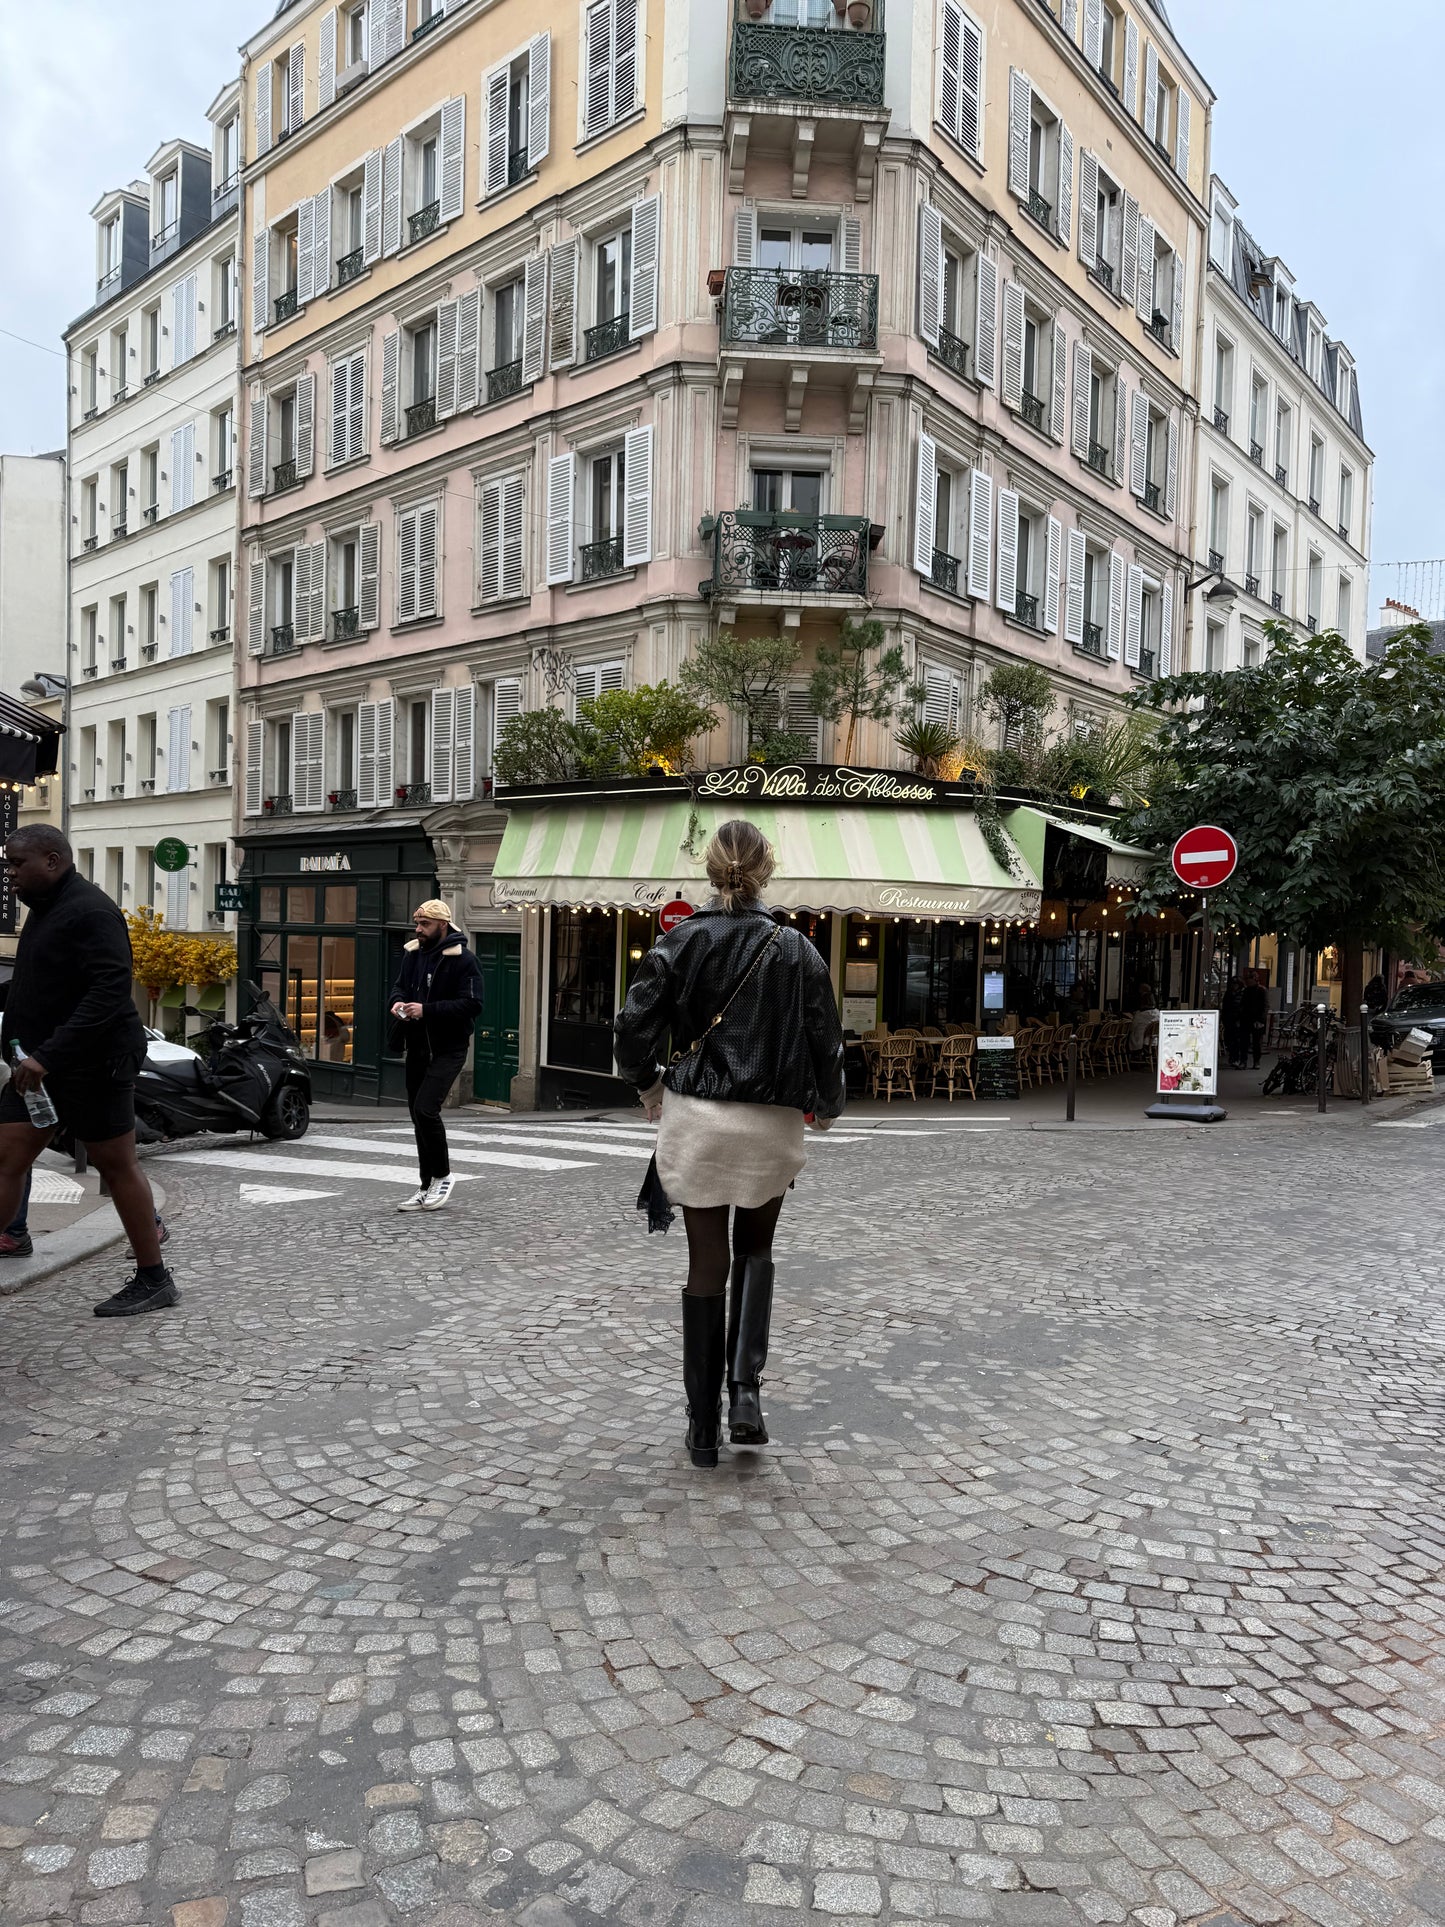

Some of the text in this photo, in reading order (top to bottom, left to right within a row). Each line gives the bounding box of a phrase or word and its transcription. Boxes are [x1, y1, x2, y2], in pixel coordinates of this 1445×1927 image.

[698, 765, 937, 801] La Villa des Abbesses
[2, 867, 10, 920] KORNER
[219, 887, 240, 897] BAU
[496, 882, 538, 897] Restaurant
[632, 882, 667, 903] Café
[879, 888, 970, 911] Restaurant
[220, 898, 243, 909] MÉA
